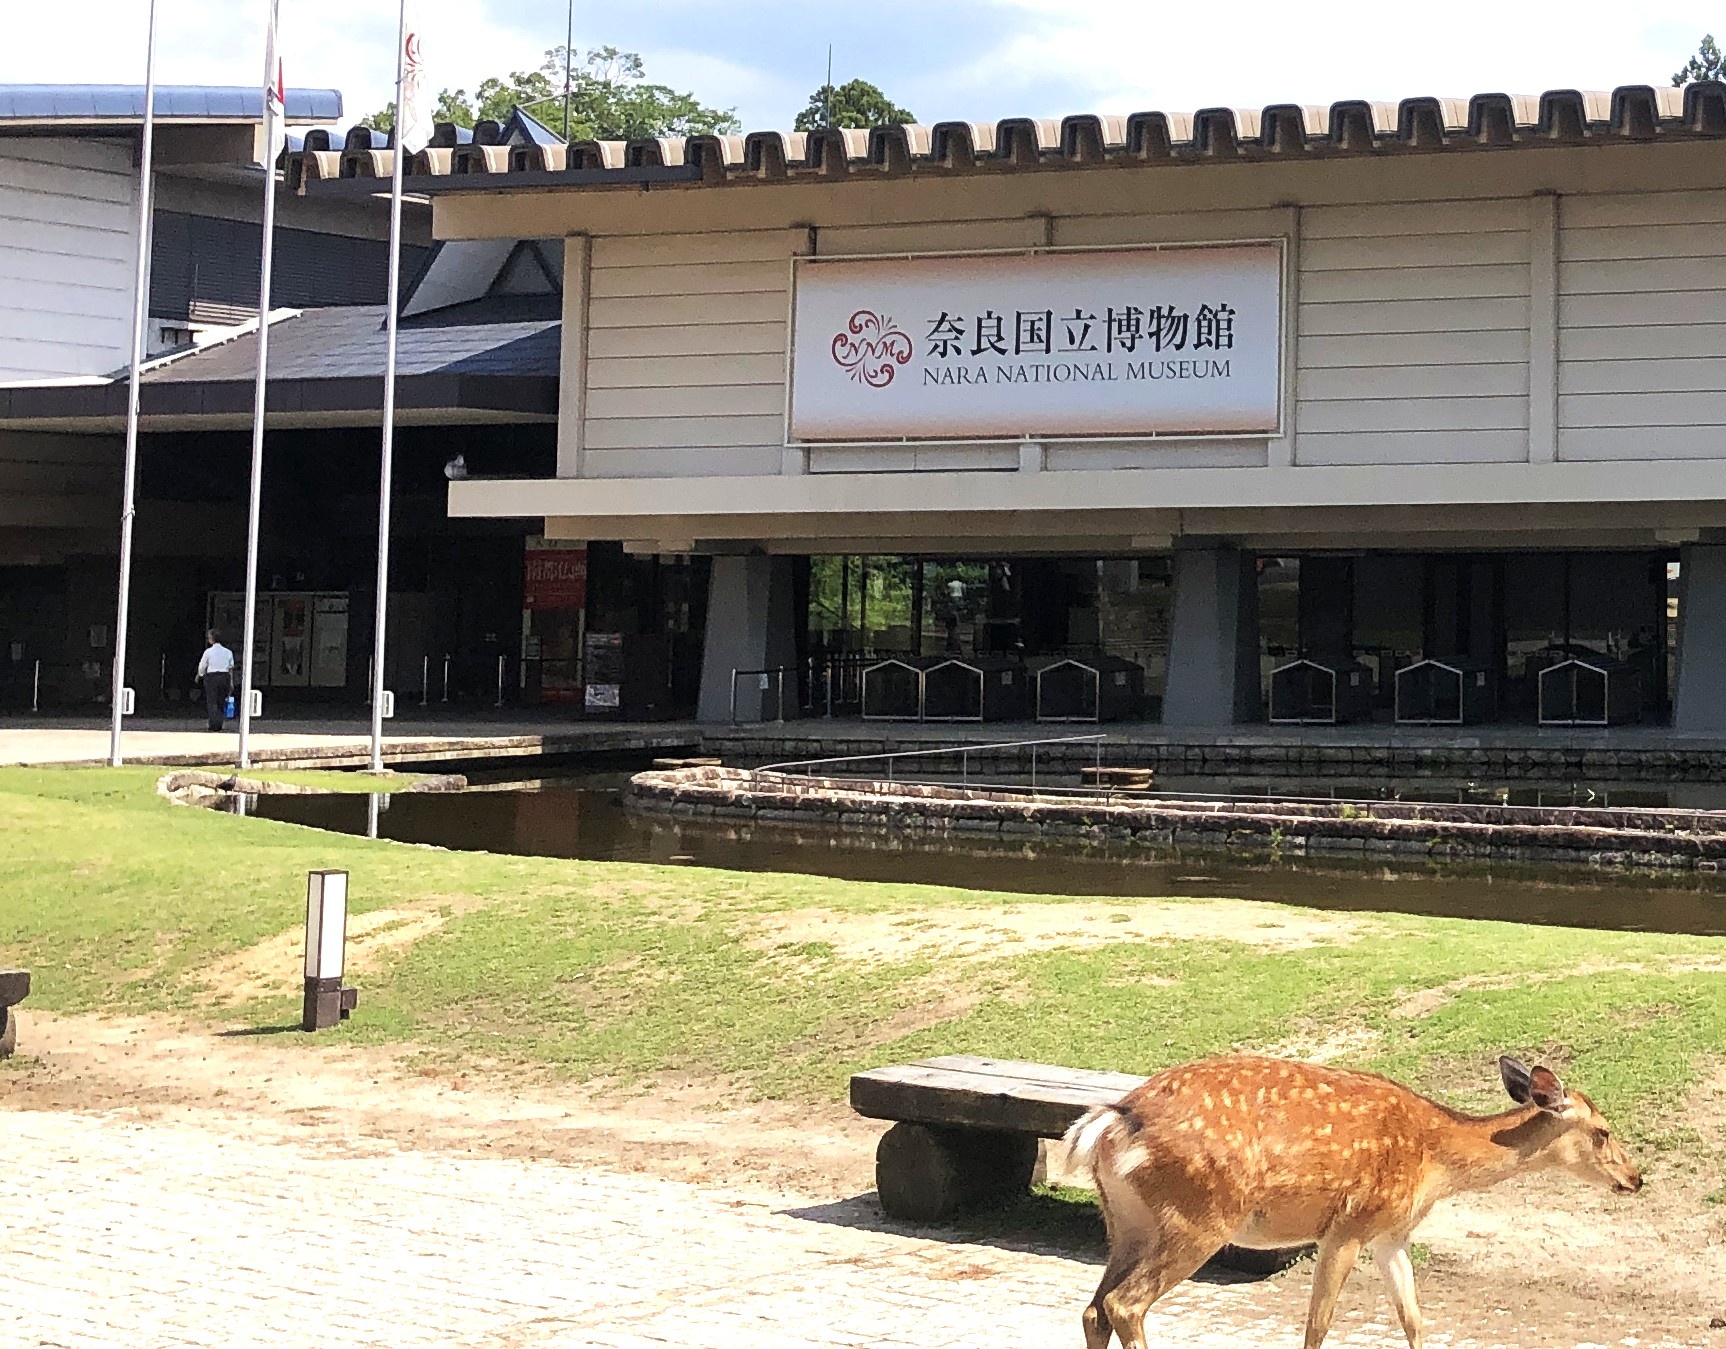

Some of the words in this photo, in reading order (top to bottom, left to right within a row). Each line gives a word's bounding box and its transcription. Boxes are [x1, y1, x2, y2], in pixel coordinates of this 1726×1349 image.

[924, 302, 1237, 359] 奈良国立博物館
[923, 364, 989, 386] NARA
[996, 362, 1118, 385] NATIONAL
[1125, 359, 1231, 380] MUSEUM
